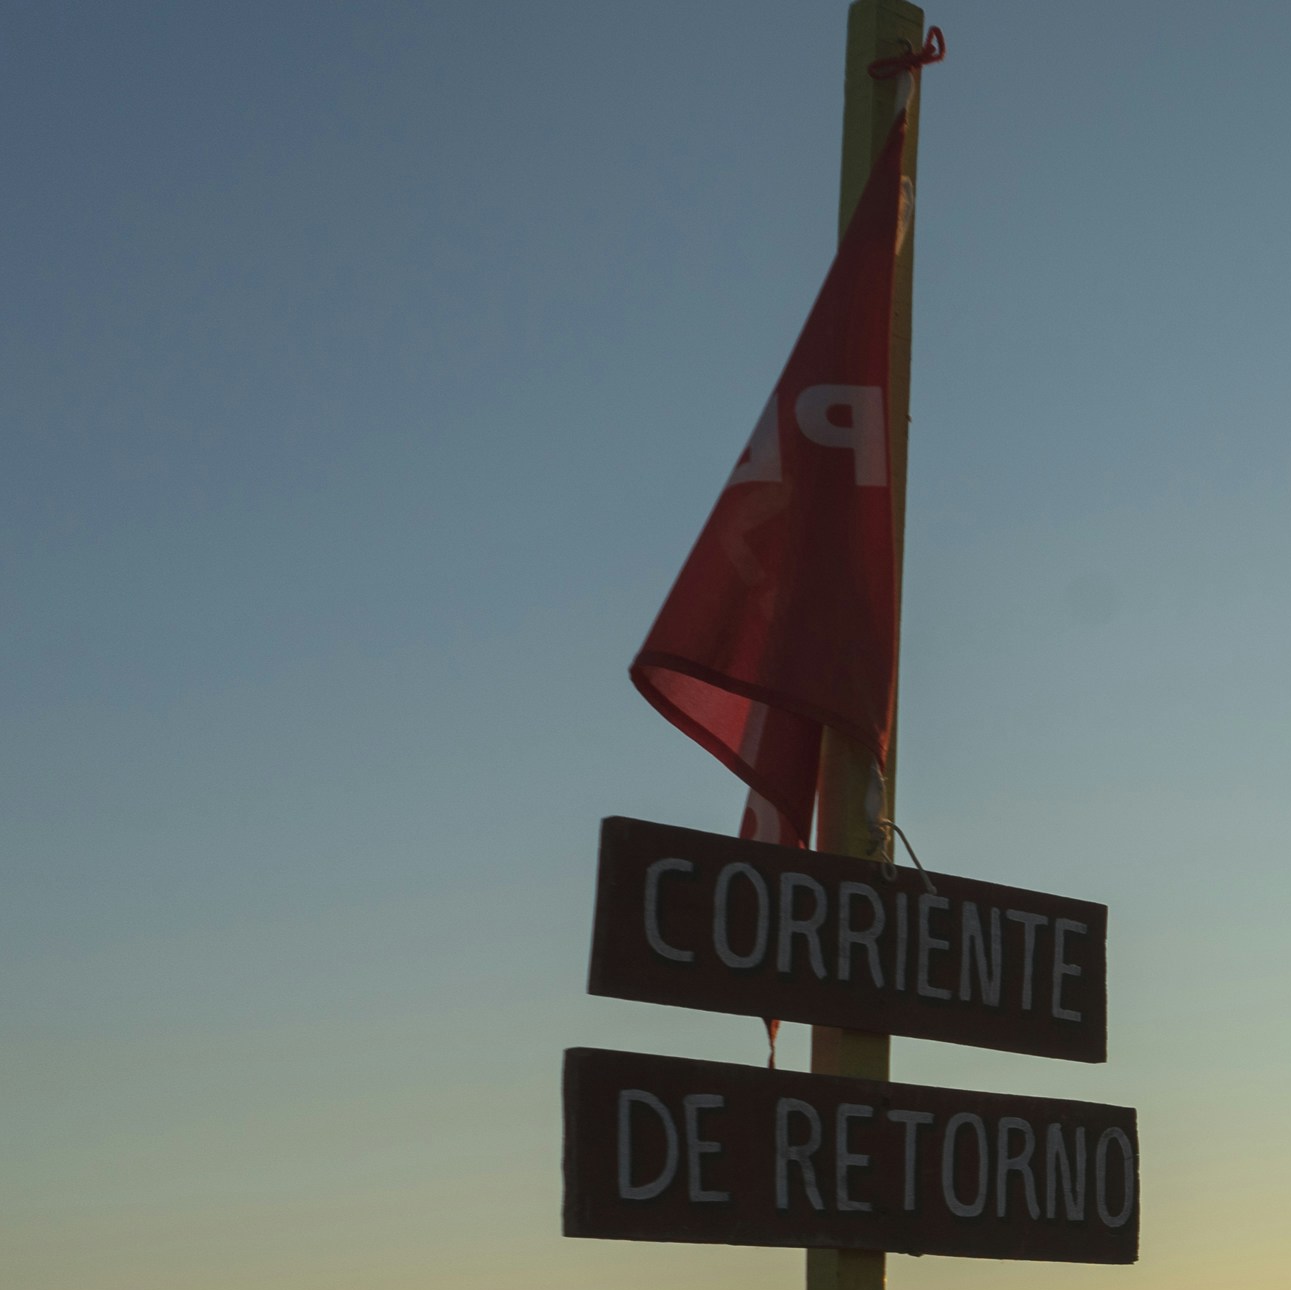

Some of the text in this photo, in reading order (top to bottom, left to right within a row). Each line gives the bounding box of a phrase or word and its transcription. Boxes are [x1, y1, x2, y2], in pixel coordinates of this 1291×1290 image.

[643, 857, 1088, 1023] CORRIENTE
[617, 1088, 1135, 1229] DE RETORNO
